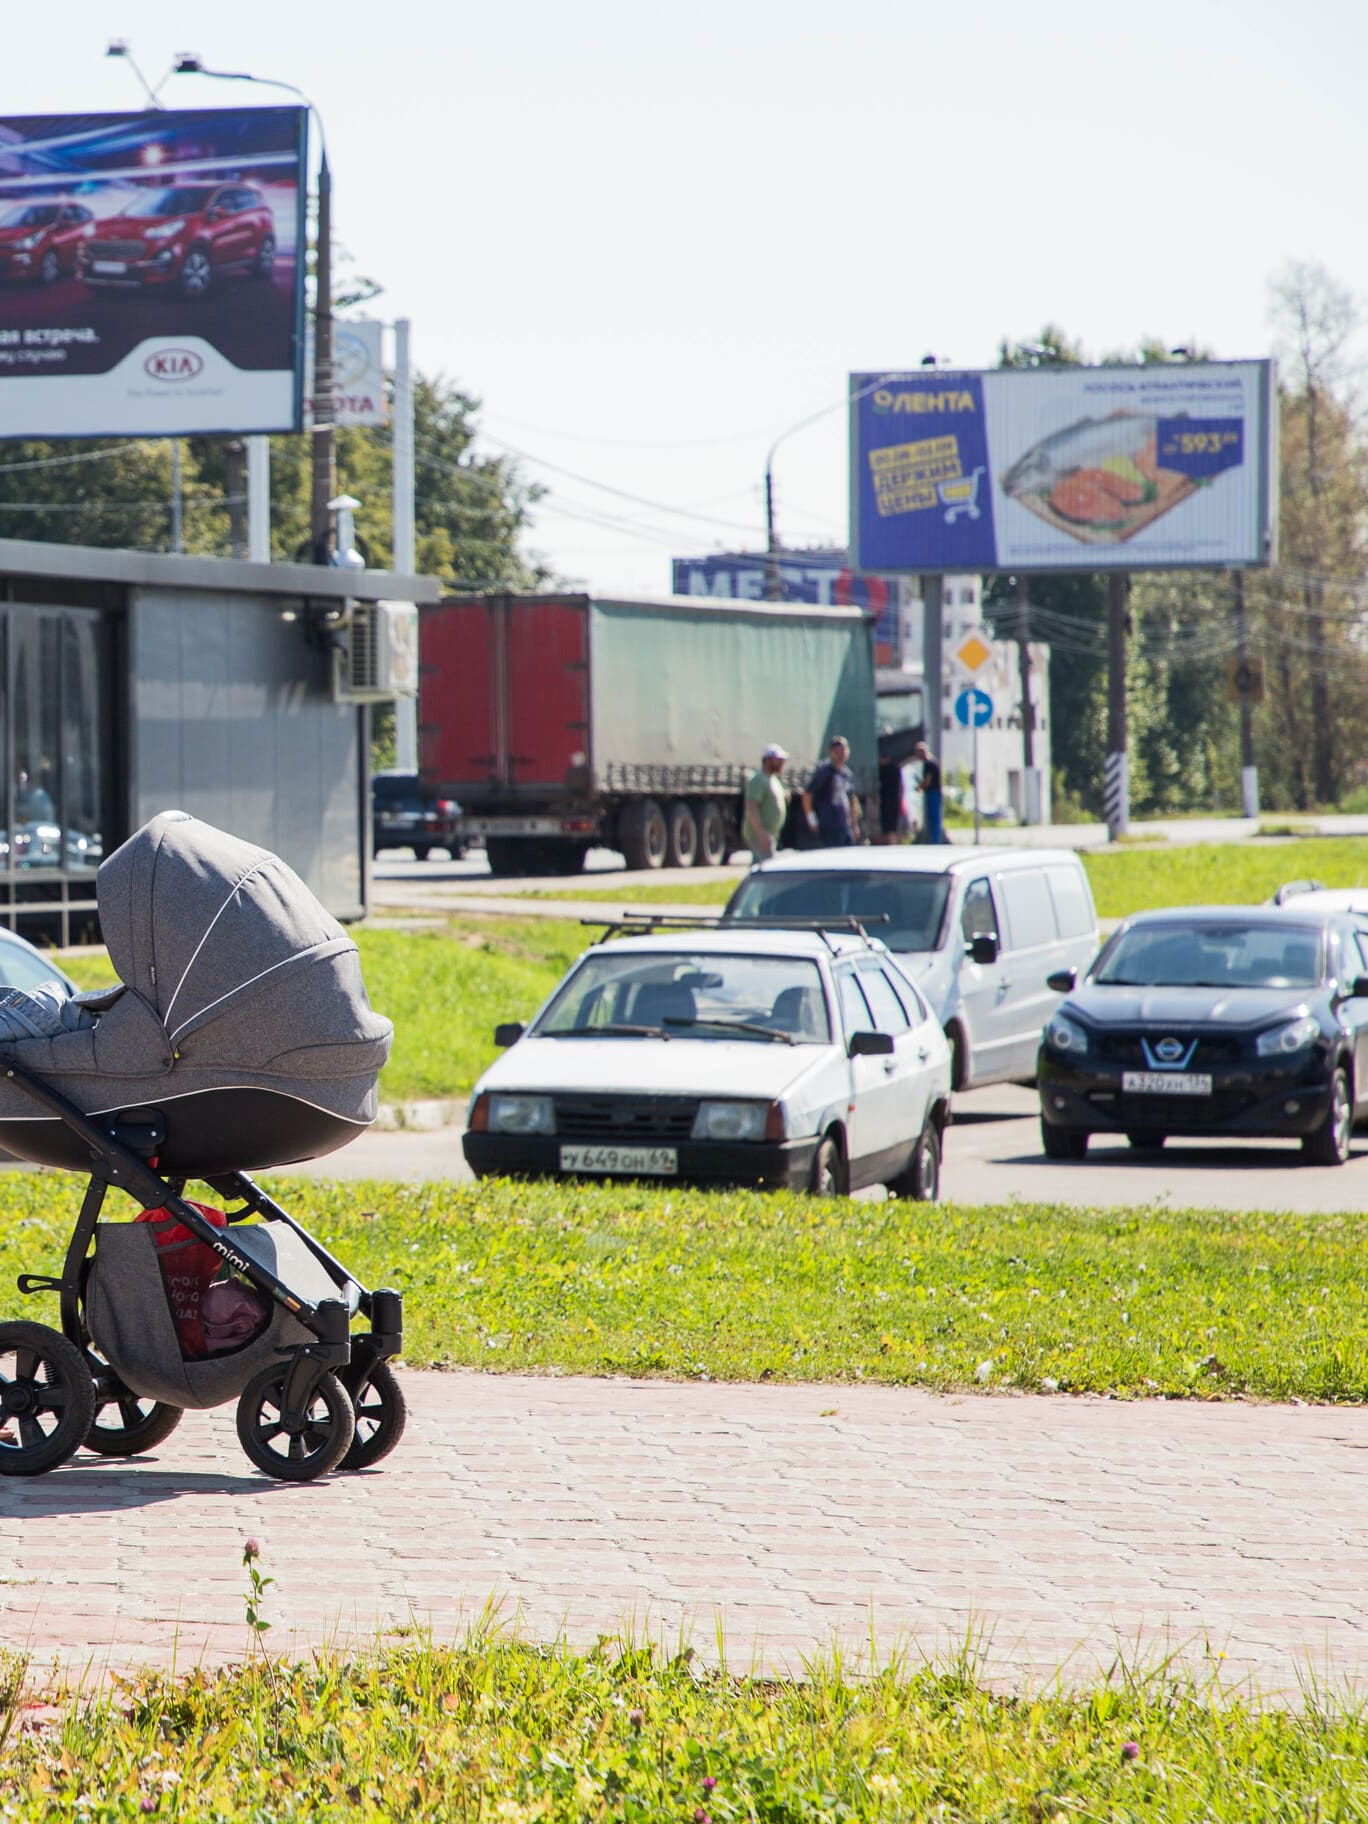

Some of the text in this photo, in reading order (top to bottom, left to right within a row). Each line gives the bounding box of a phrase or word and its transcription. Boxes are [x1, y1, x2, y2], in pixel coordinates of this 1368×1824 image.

[155, 357, 193, 373] KIA
[893, 391, 975, 414] ЛЕНТА
[650, 1150, 668, 1165] 69
[212, 1242, 250, 1272] mimi
